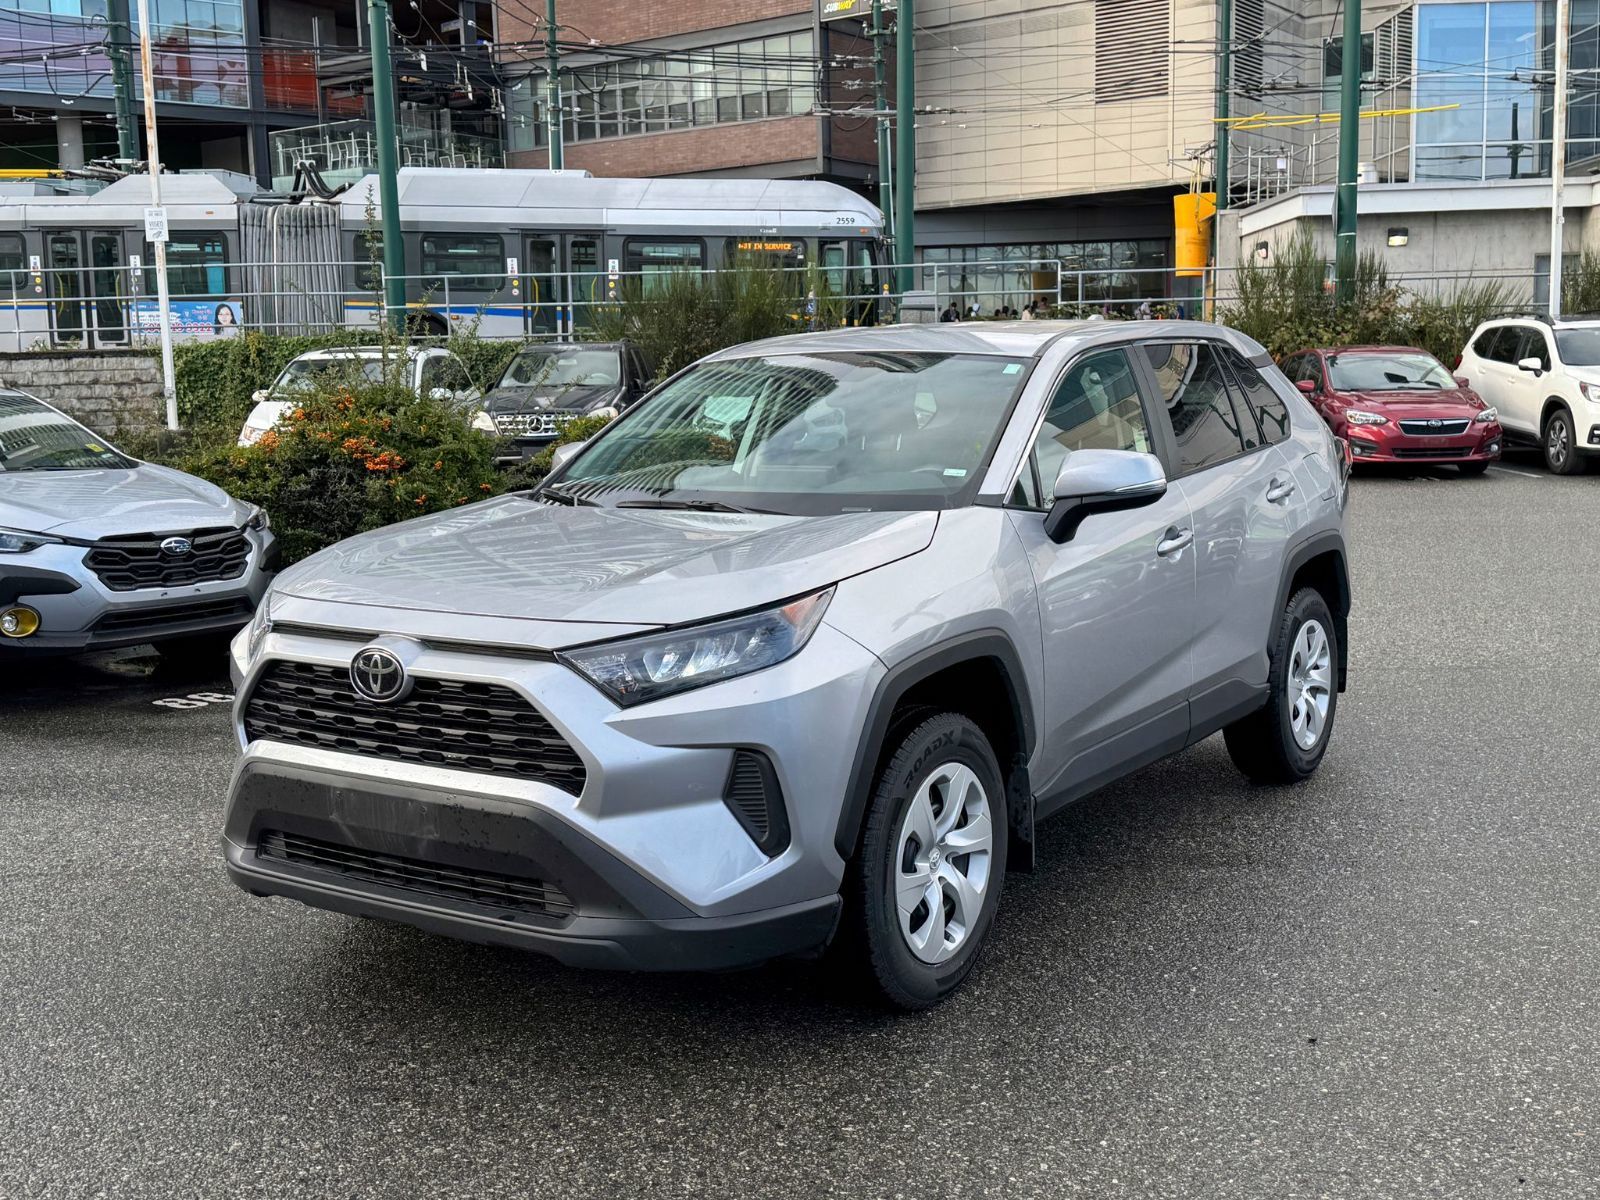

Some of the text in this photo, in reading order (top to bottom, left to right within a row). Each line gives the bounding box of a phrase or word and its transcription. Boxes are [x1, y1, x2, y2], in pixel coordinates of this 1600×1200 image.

[824, 0, 856, 13] SUBWAY
[836, 217, 855, 225] 2559
[903, 730, 954, 789] ROADX
